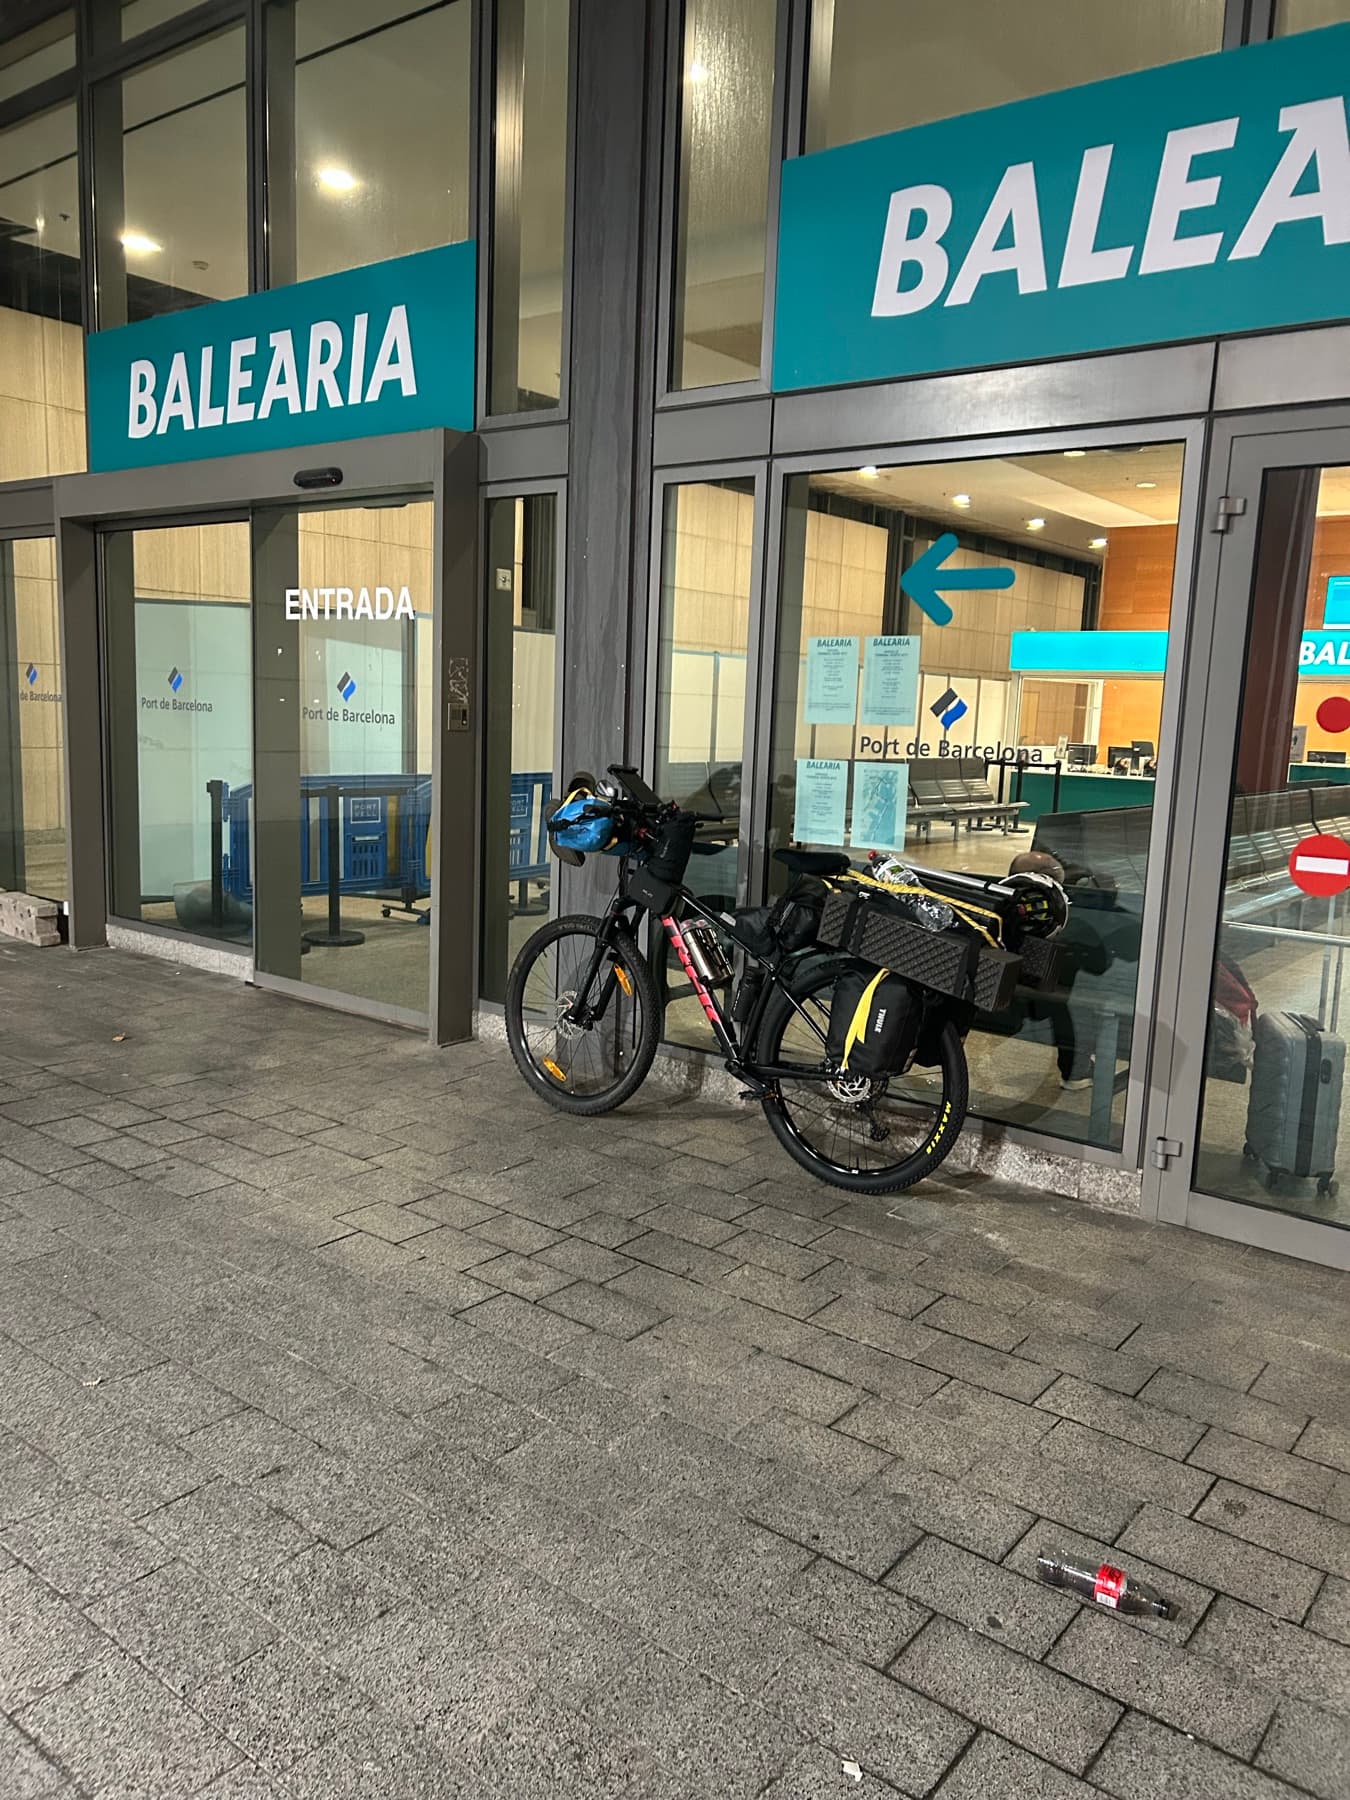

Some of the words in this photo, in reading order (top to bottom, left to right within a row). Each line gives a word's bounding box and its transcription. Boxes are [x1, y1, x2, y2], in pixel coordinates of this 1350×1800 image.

[284, 586, 416, 621] ENTRADA
[141, 697, 158, 710] Port
[160, 698, 170, 711] de
[172, 699, 213, 713] Barcelona
[303, 707, 323, 721] Port
[326, 707, 339, 721] de
[342, 709, 395, 725] Barcelona
[860, 736, 899, 755] Port
[906, 738, 930, 756] de
[939, 740, 1042, 763] Barcelona
[874, 1008, 886, 1034] THULE
